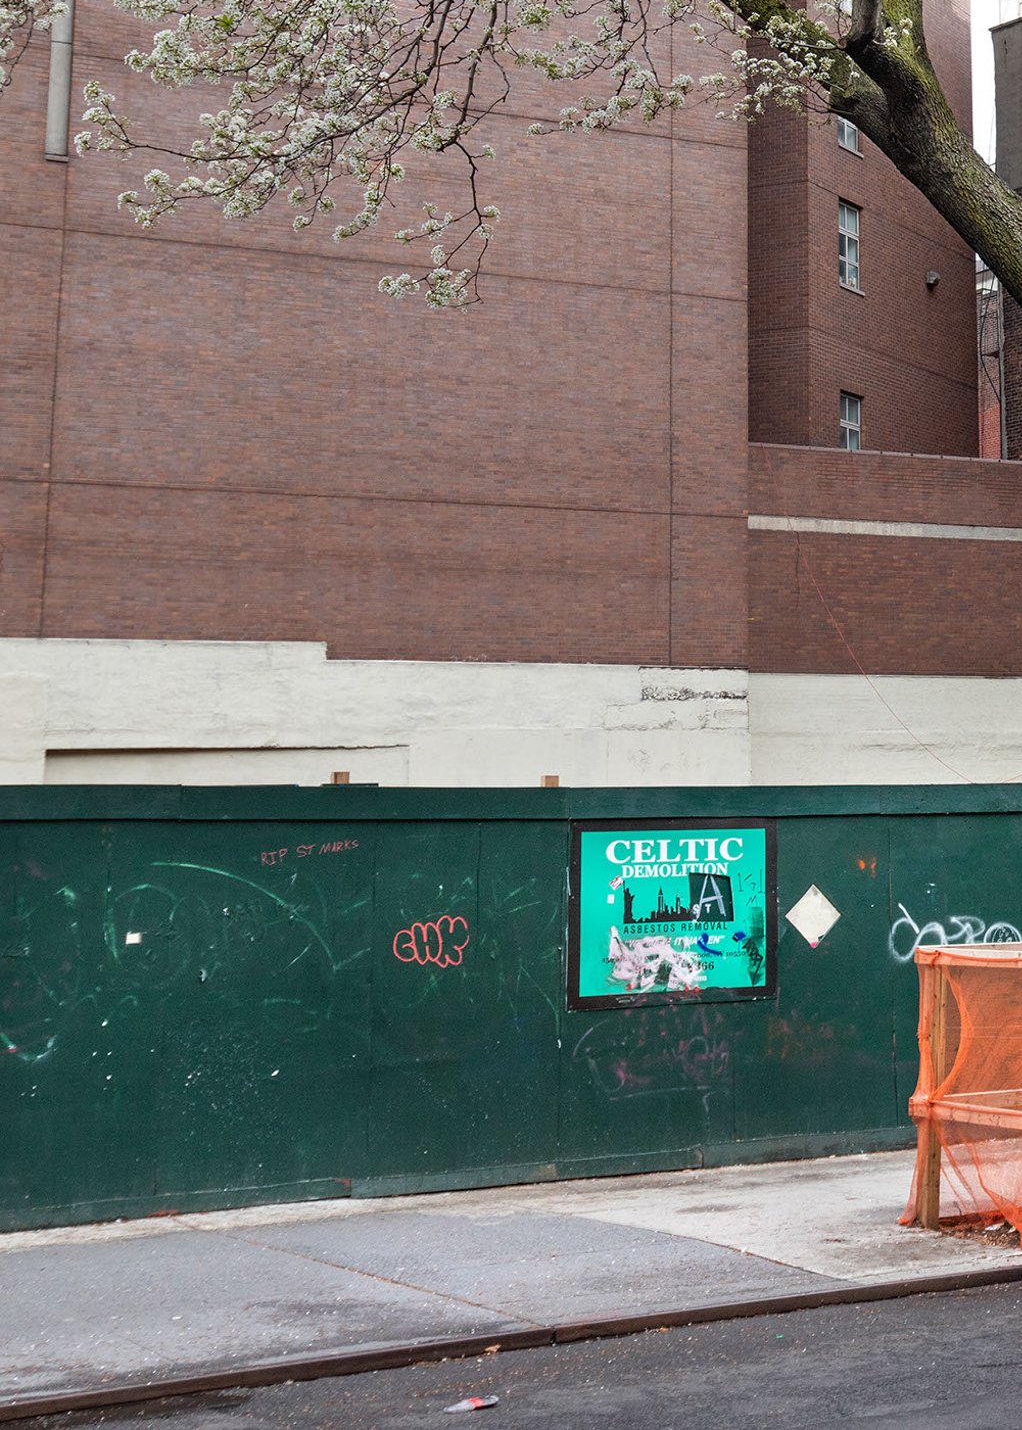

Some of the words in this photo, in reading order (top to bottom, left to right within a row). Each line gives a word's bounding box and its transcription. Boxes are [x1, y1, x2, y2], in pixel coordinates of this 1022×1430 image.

[261, 847, 288, 866] RIP
[296, 843, 317, 858] ST
[319, 839, 360, 855] MARKS
[605, 837, 744, 864] CELTIC
[621, 862, 729, 879] DEMOLITION
[623, 923, 676, 934] ASBESTOS
[681, 921, 728, 931] REMOVAL
